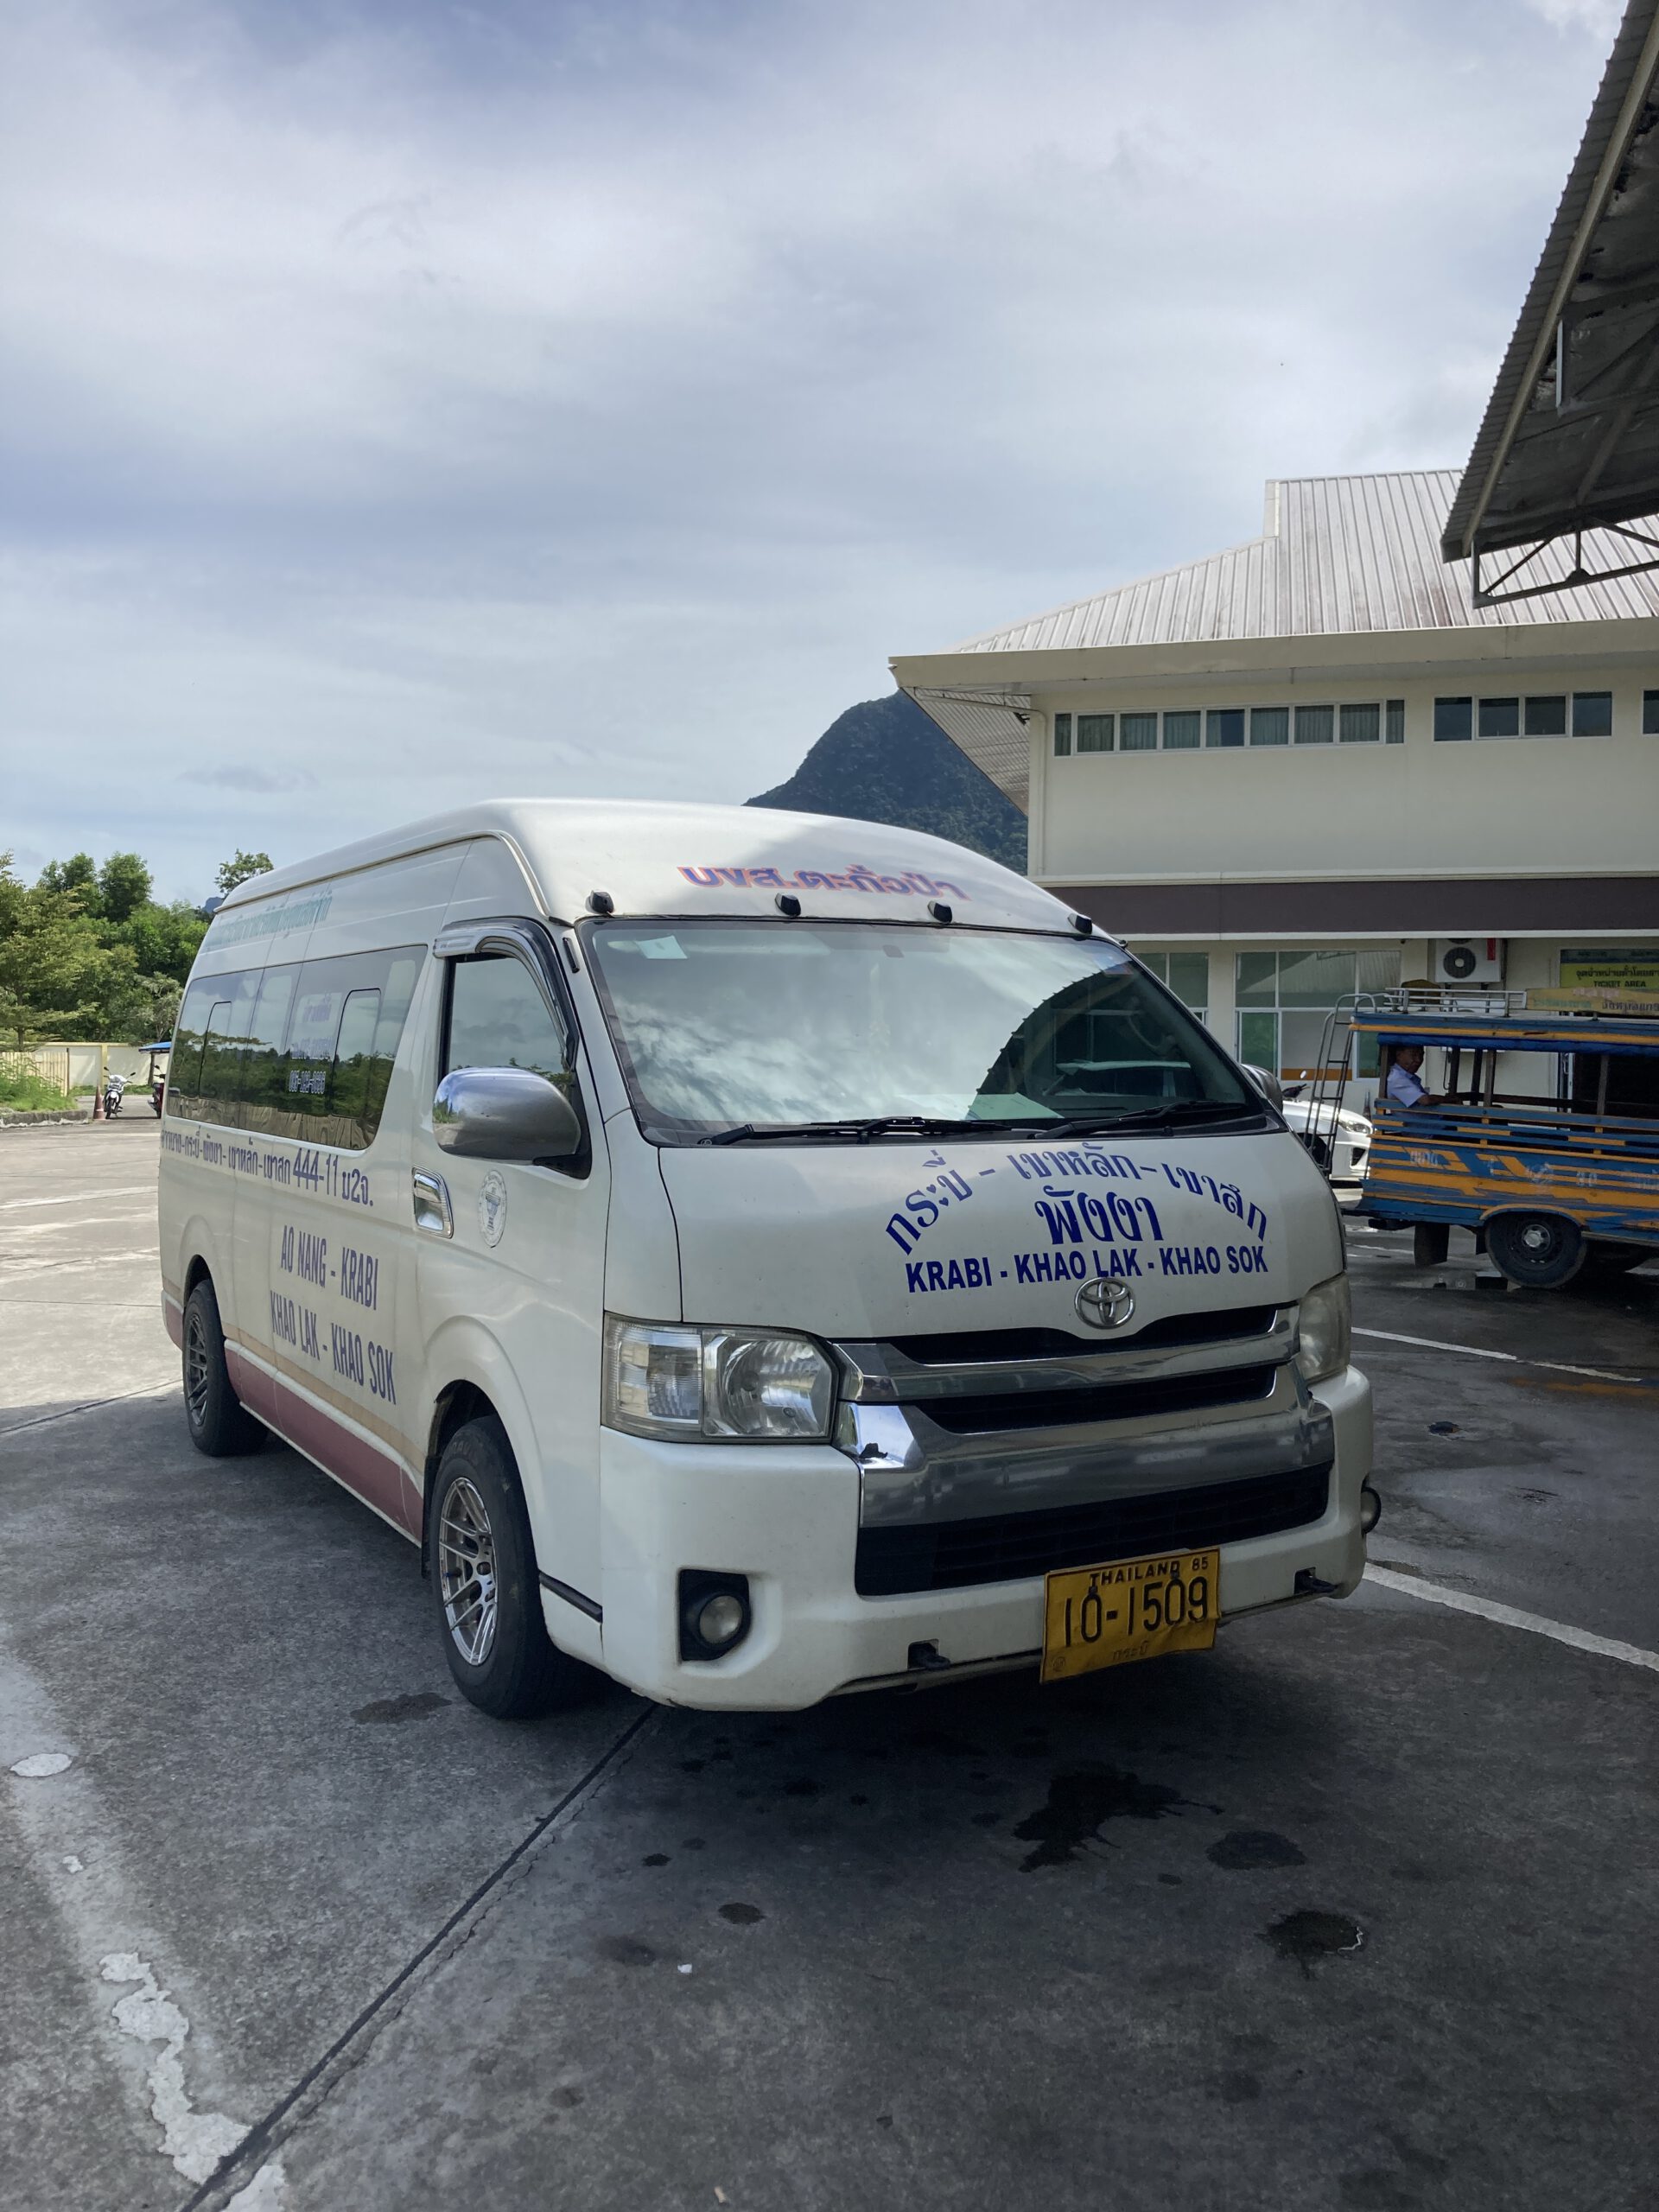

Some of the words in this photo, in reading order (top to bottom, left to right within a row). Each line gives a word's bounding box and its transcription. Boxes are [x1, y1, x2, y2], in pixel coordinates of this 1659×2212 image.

[293, 1147, 339, 1197] 444-11
[1034, 1185, 1164, 1245] พังงา
[281, 1225, 295, 1273] AO
[297, 1230, 327, 1288] NANG
[340, 1247, 378, 1311] KRABI
[906, 1256, 992, 1293] KRABI
[1014, 1250, 1086, 1284] KHAO
[1092, 1247, 1142, 1277] LAK
[1159, 1246, 1221, 1275] KHAO
[1227, 1245, 1268, 1274] SOK
[270, 1290, 296, 1346] KHAO
[299, 1305, 320, 1361] LAK
[331, 1323, 364, 1386] KHAO
[368, 1341, 397, 1405] SOK
[1090, 1560, 1180, 1589] THAILAND
[1192, 1556, 1209, 1572] 85
[1065, 1576, 1208, 1648] 10-1509
